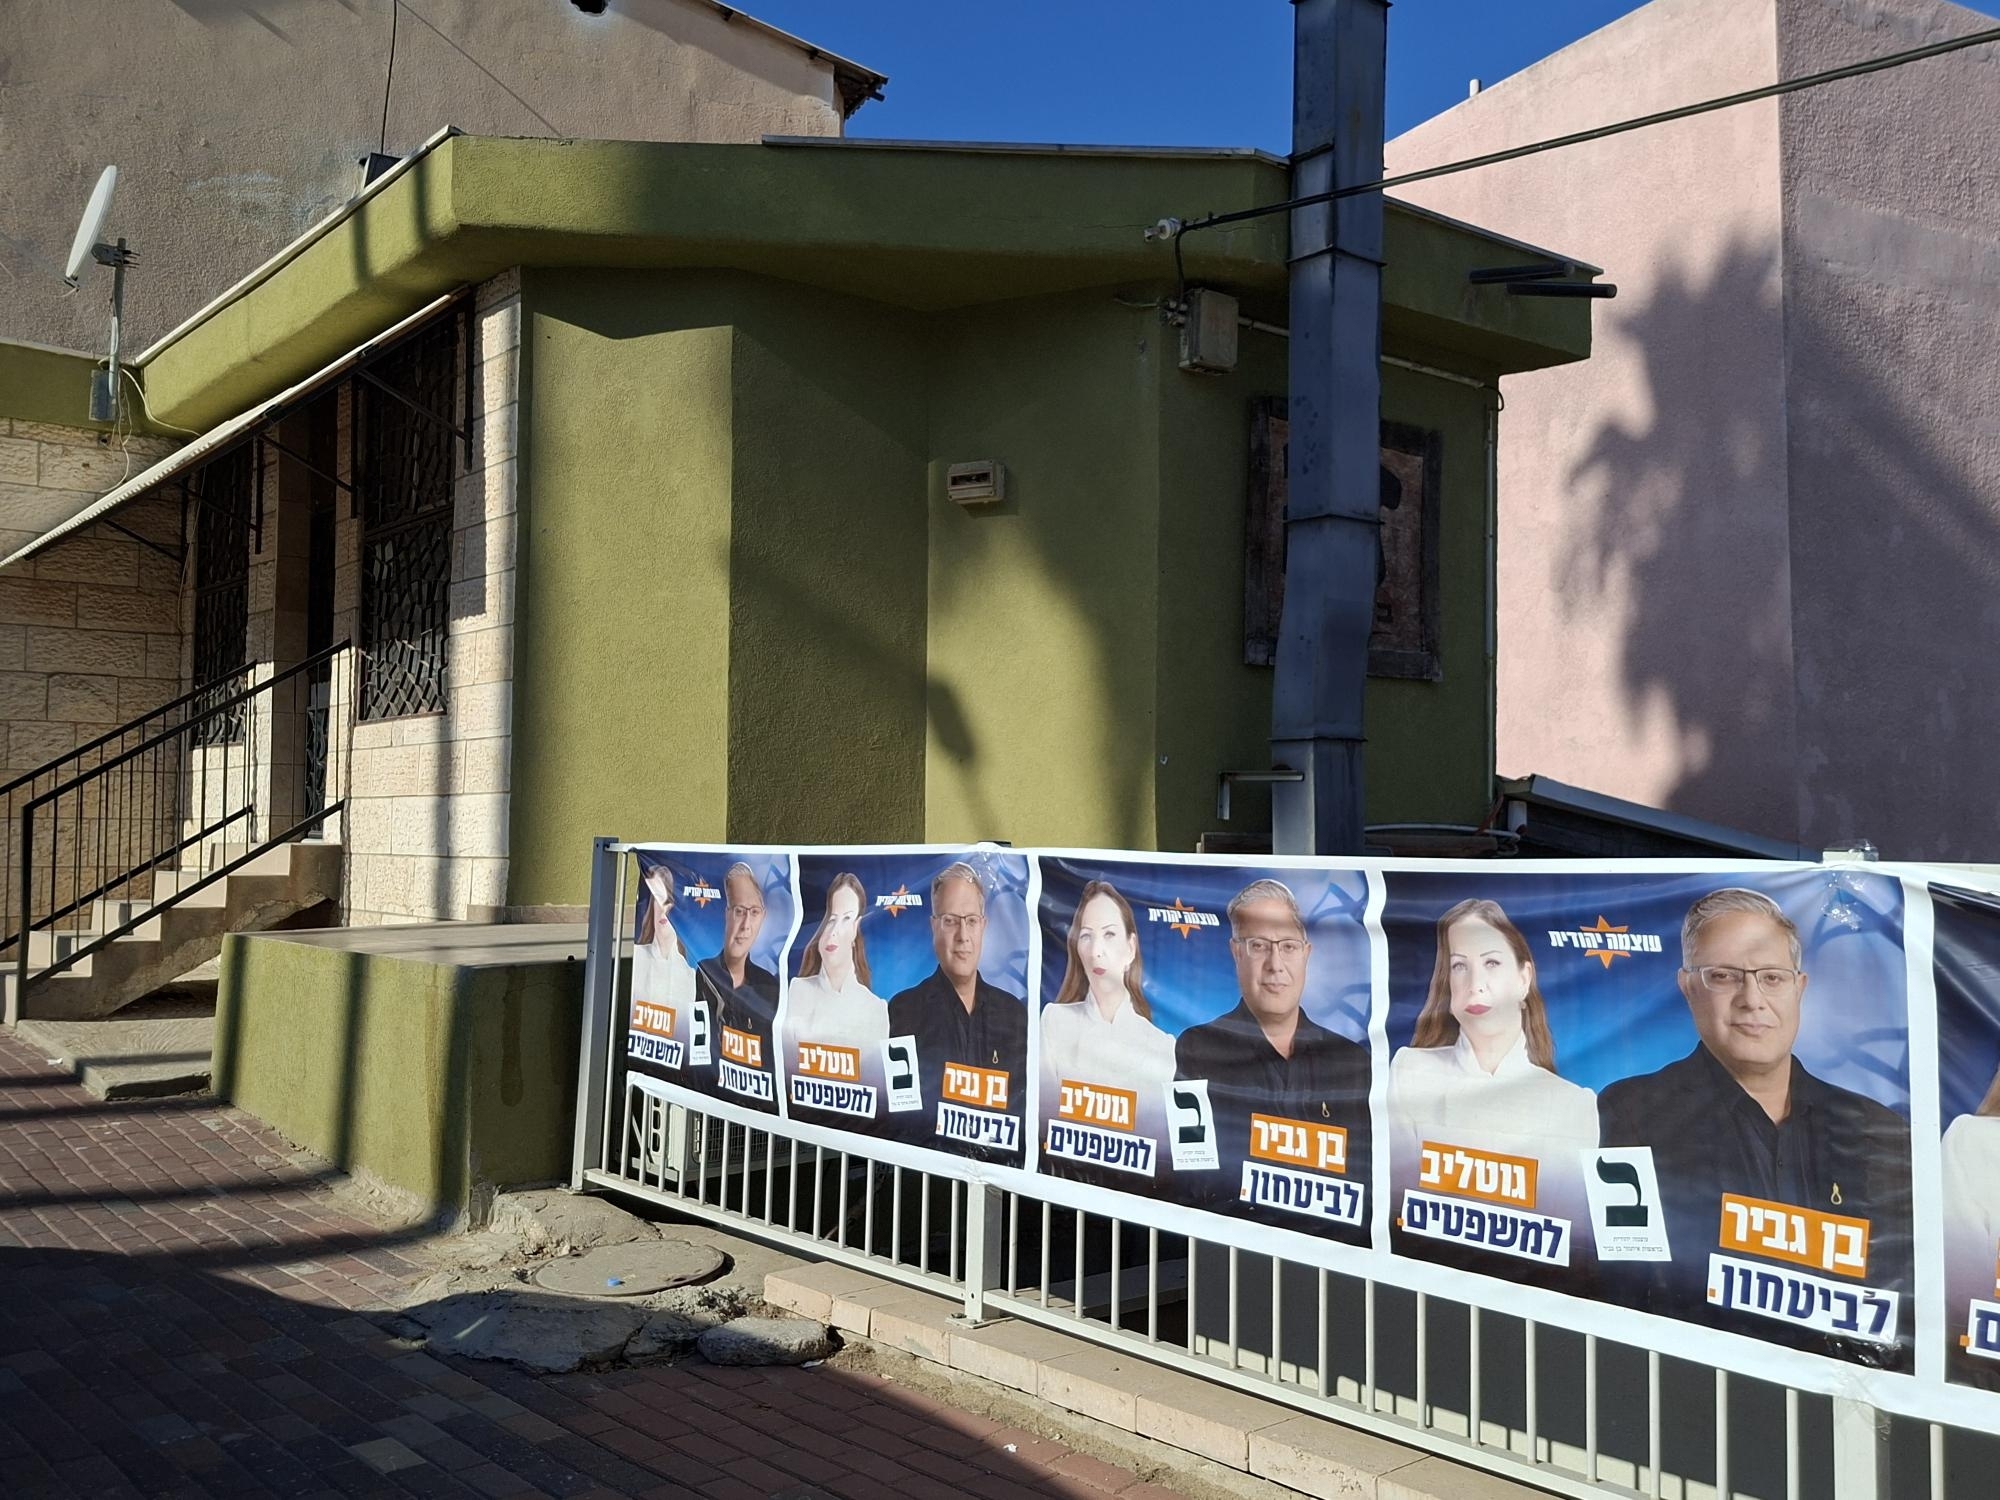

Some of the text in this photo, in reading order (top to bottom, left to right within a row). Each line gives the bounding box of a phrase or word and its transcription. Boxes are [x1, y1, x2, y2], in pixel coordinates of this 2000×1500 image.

[1148, 908, 1220, 926] עוצמה יהודית
[1548, 931, 1662, 952] עוצמה יהודית
[633, 1003, 671, 1033] גוטליב
[723, 1029, 761, 1064] בן גביר
[799, 1046, 855, 1076] גוטליב
[888, 1043, 913, 1090] ב
[945, 1067, 1007, 1106] בן גביר
[1059, 1085, 1129, 1124] גוטליב
[1173, 1087, 1206, 1143] ב
[1253, 1119, 1345, 1168] בן גביר
[1420, 1149, 1526, 1200] גוטליב
[1596, 1155, 1648, 1227] ב
[1725, 1202, 1864, 1270] בן גביר
